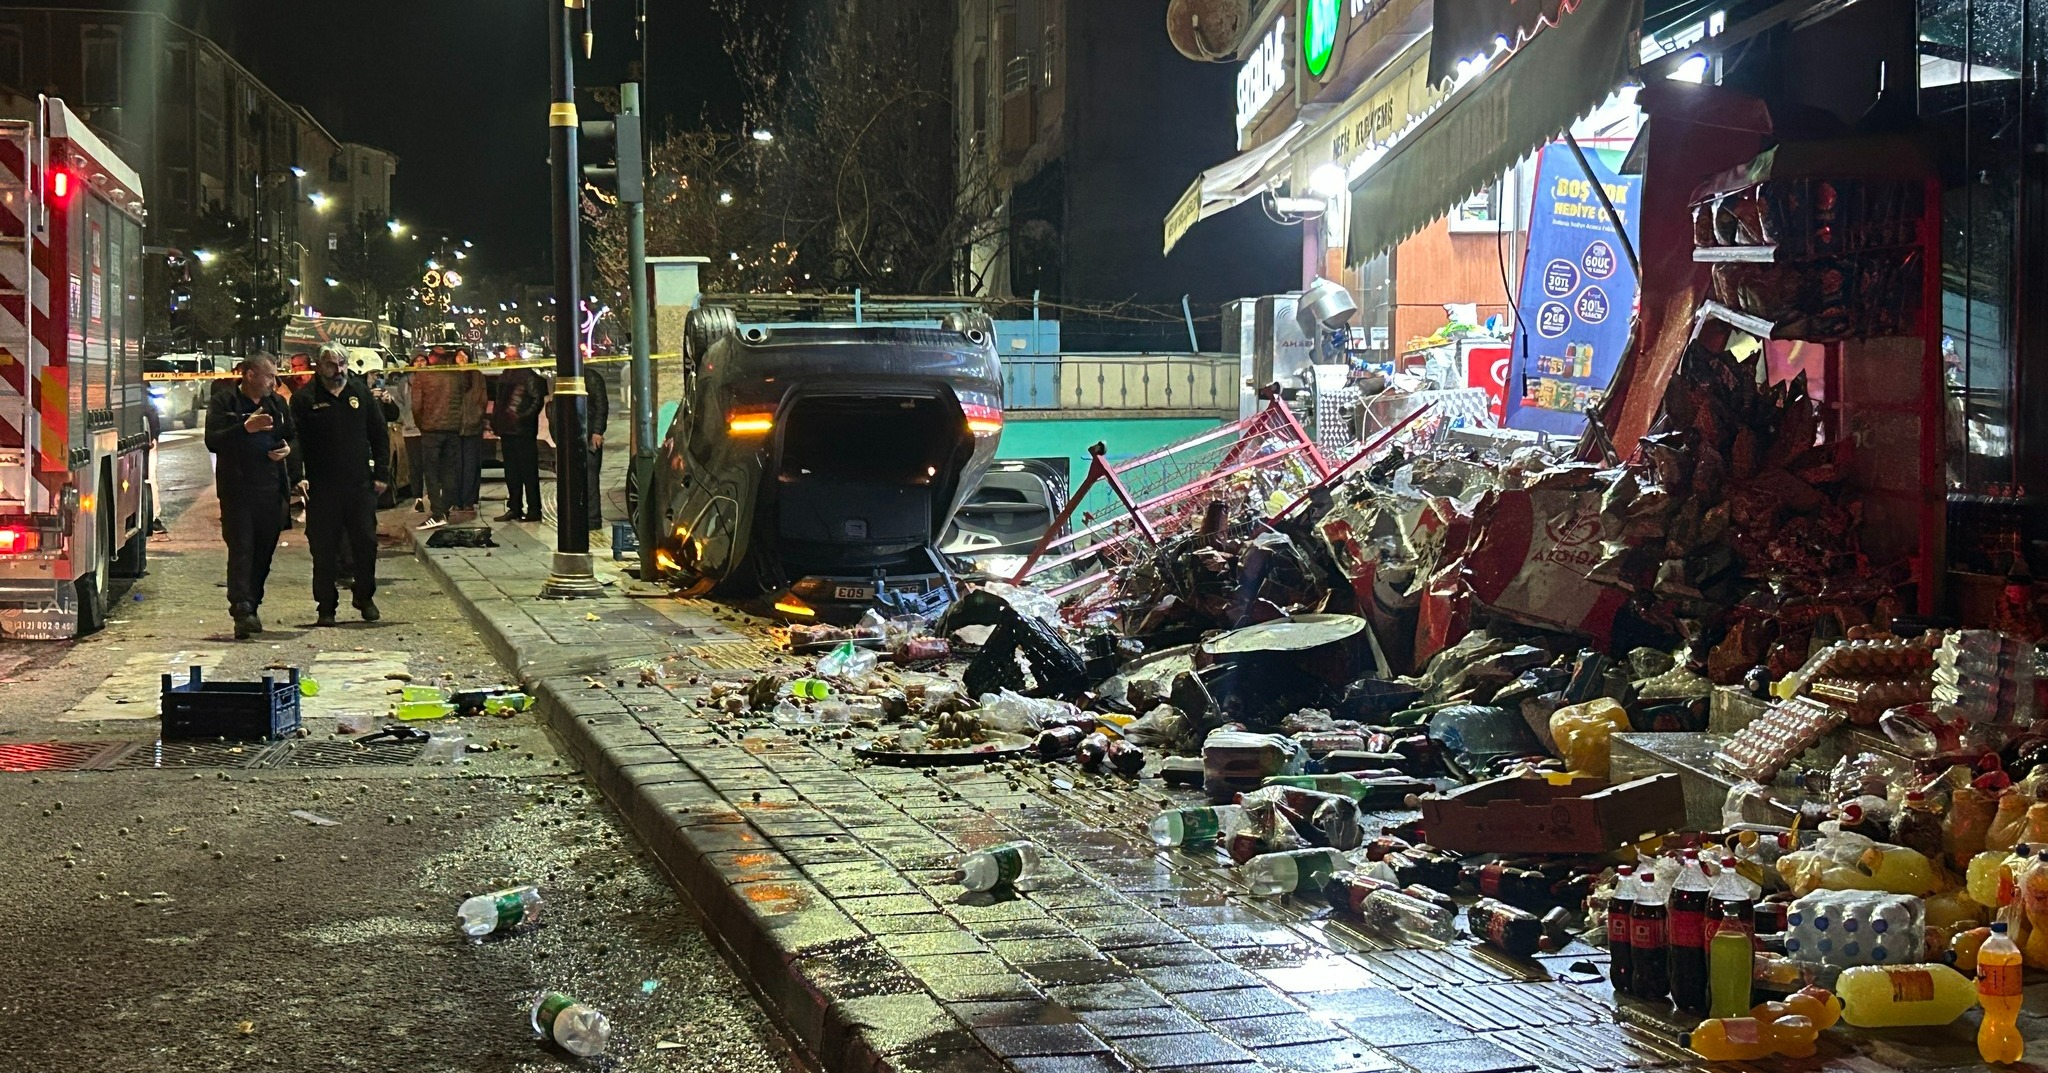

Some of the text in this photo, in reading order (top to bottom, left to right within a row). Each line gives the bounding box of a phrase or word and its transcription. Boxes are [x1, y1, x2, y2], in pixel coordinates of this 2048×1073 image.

[1556, 178, 1591, 202] BOŞ
[1553, 202, 1596, 219] HEDİYE
[327, 321, 367, 337] MNC
